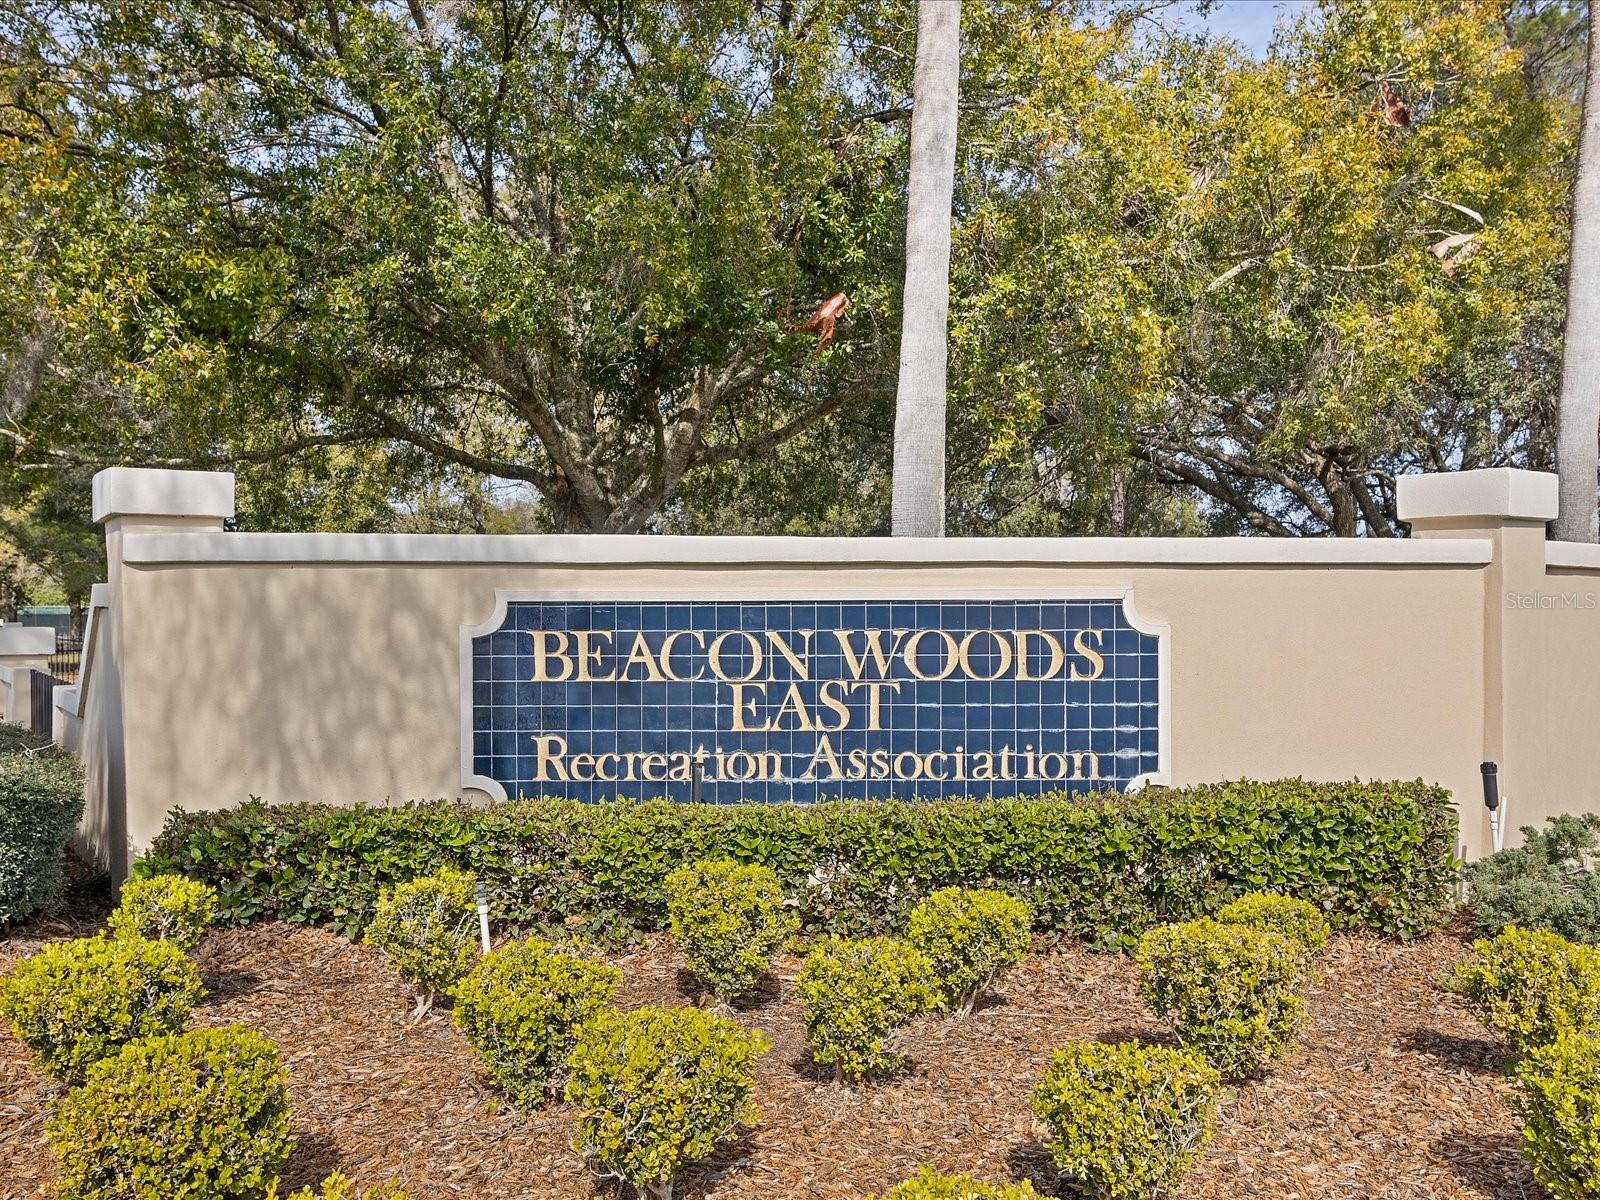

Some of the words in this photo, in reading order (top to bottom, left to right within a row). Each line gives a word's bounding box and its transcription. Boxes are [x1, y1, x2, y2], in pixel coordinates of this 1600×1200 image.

[527, 629, 815, 683] BEACON
[834, 628, 1105, 682] WOODS
[728, 681, 901, 733] EAST
[530, 734, 785, 782] Recreation
[800, 734, 1101, 781] Association
